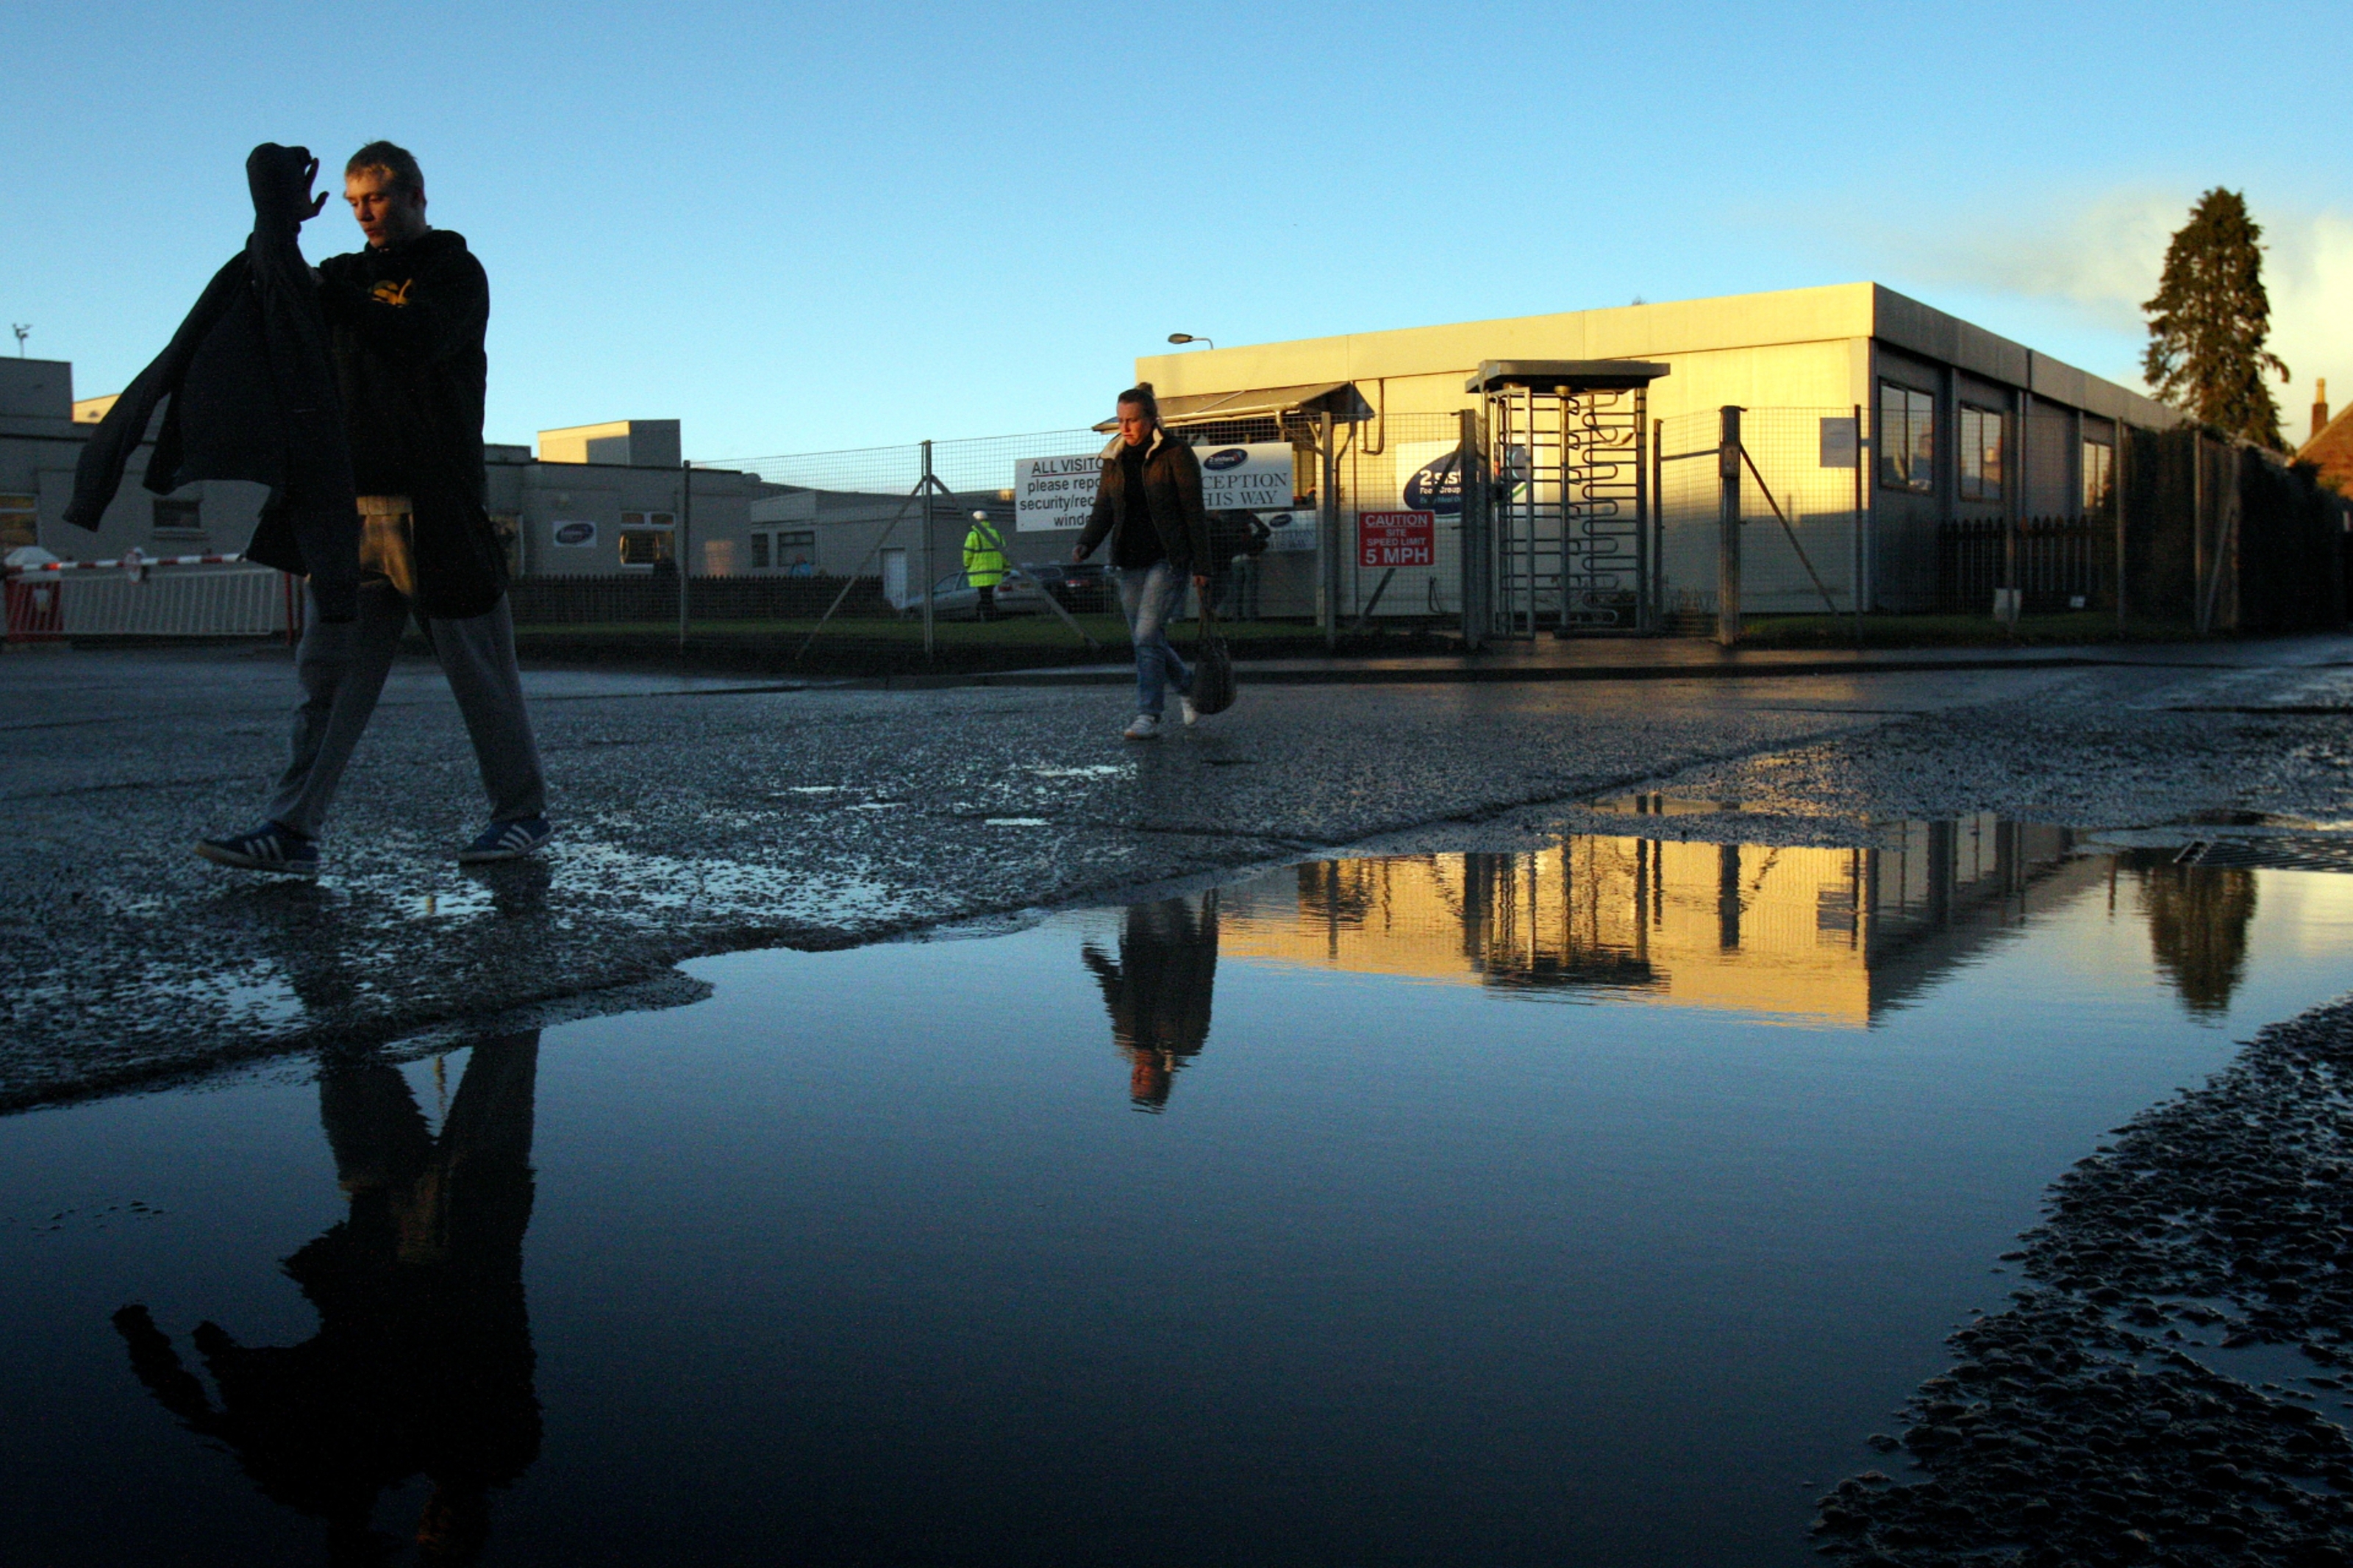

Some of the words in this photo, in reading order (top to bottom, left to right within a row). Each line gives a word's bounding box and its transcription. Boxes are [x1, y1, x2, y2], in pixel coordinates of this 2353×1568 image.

[1032, 461, 1057, 474] ALL
[1028, 479, 1069, 495] please
[1240, 490, 1278, 505] WAY
[1365, 515, 1428, 526] CAUTION
[1386, 529, 1407, 537] SITE
[1367, 538, 1399, 546] SPEED
[1400, 537, 1427, 546] LIMIT
[1365, 548, 1377, 565] 5
[1383, 547, 1429, 563] MPH
